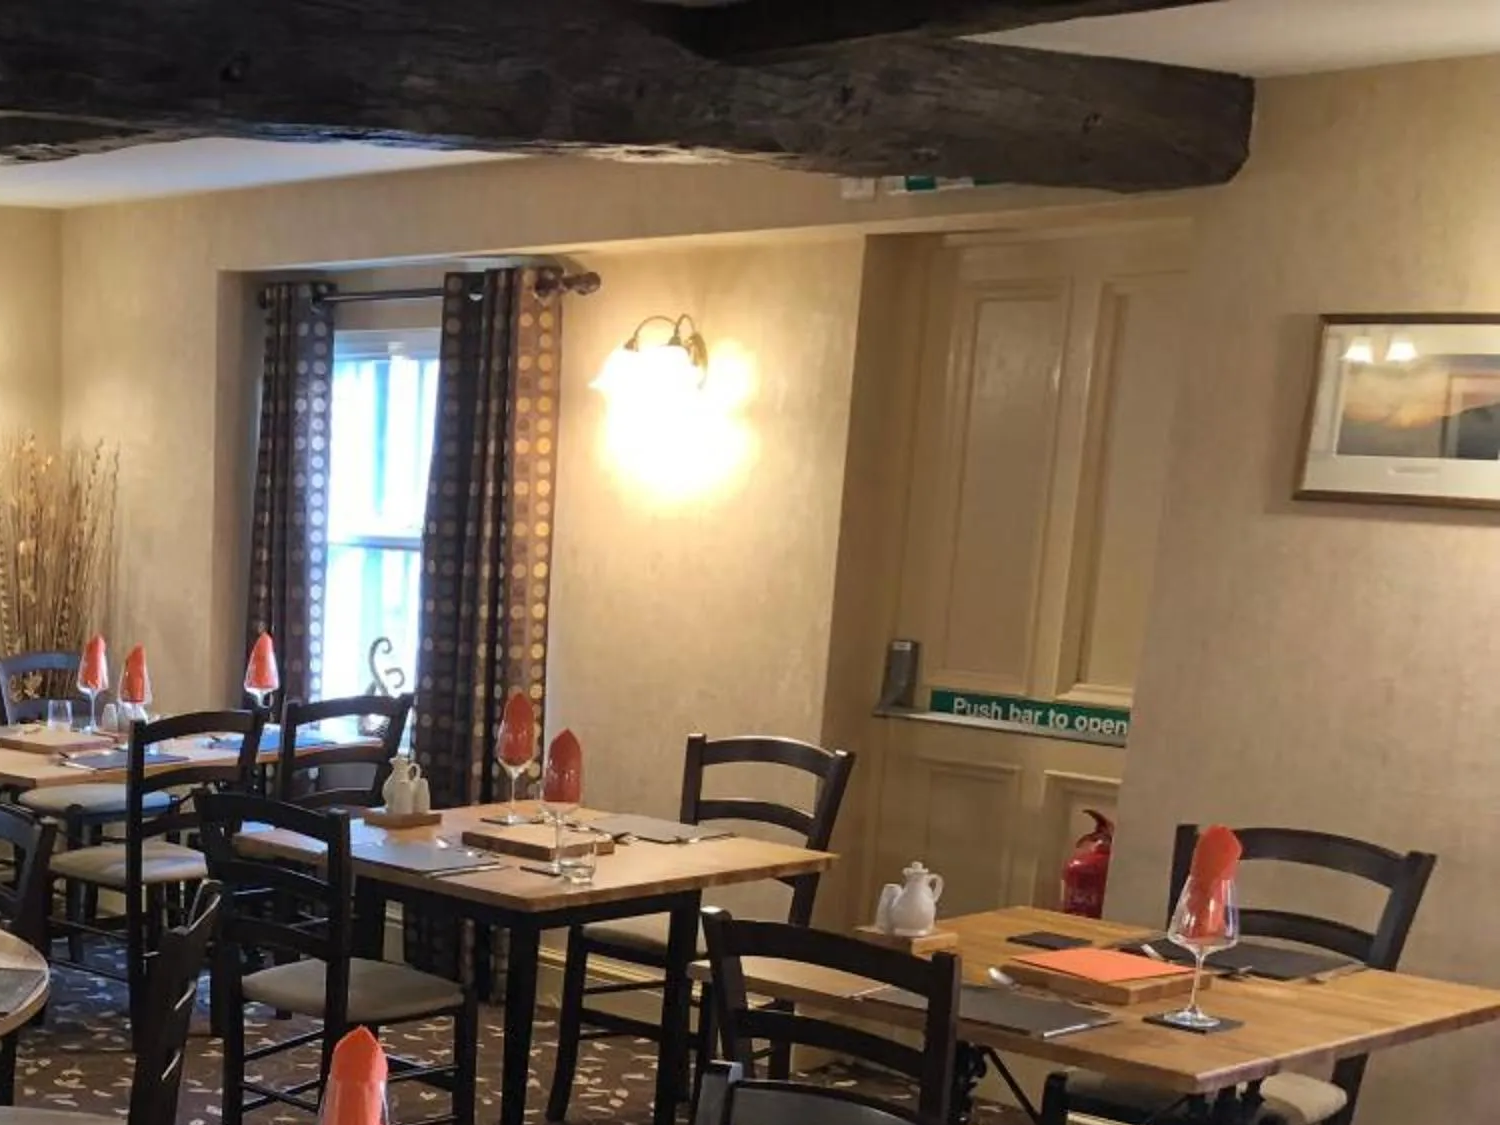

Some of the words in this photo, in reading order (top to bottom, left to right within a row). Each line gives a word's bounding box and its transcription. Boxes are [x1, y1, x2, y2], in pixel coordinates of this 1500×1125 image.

[953, 697, 1002, 720] Push
[1009, 703, 1044, 725] bar
[1047, 709, 1069, 729] to
[1075, 716, 1128, 735] open
